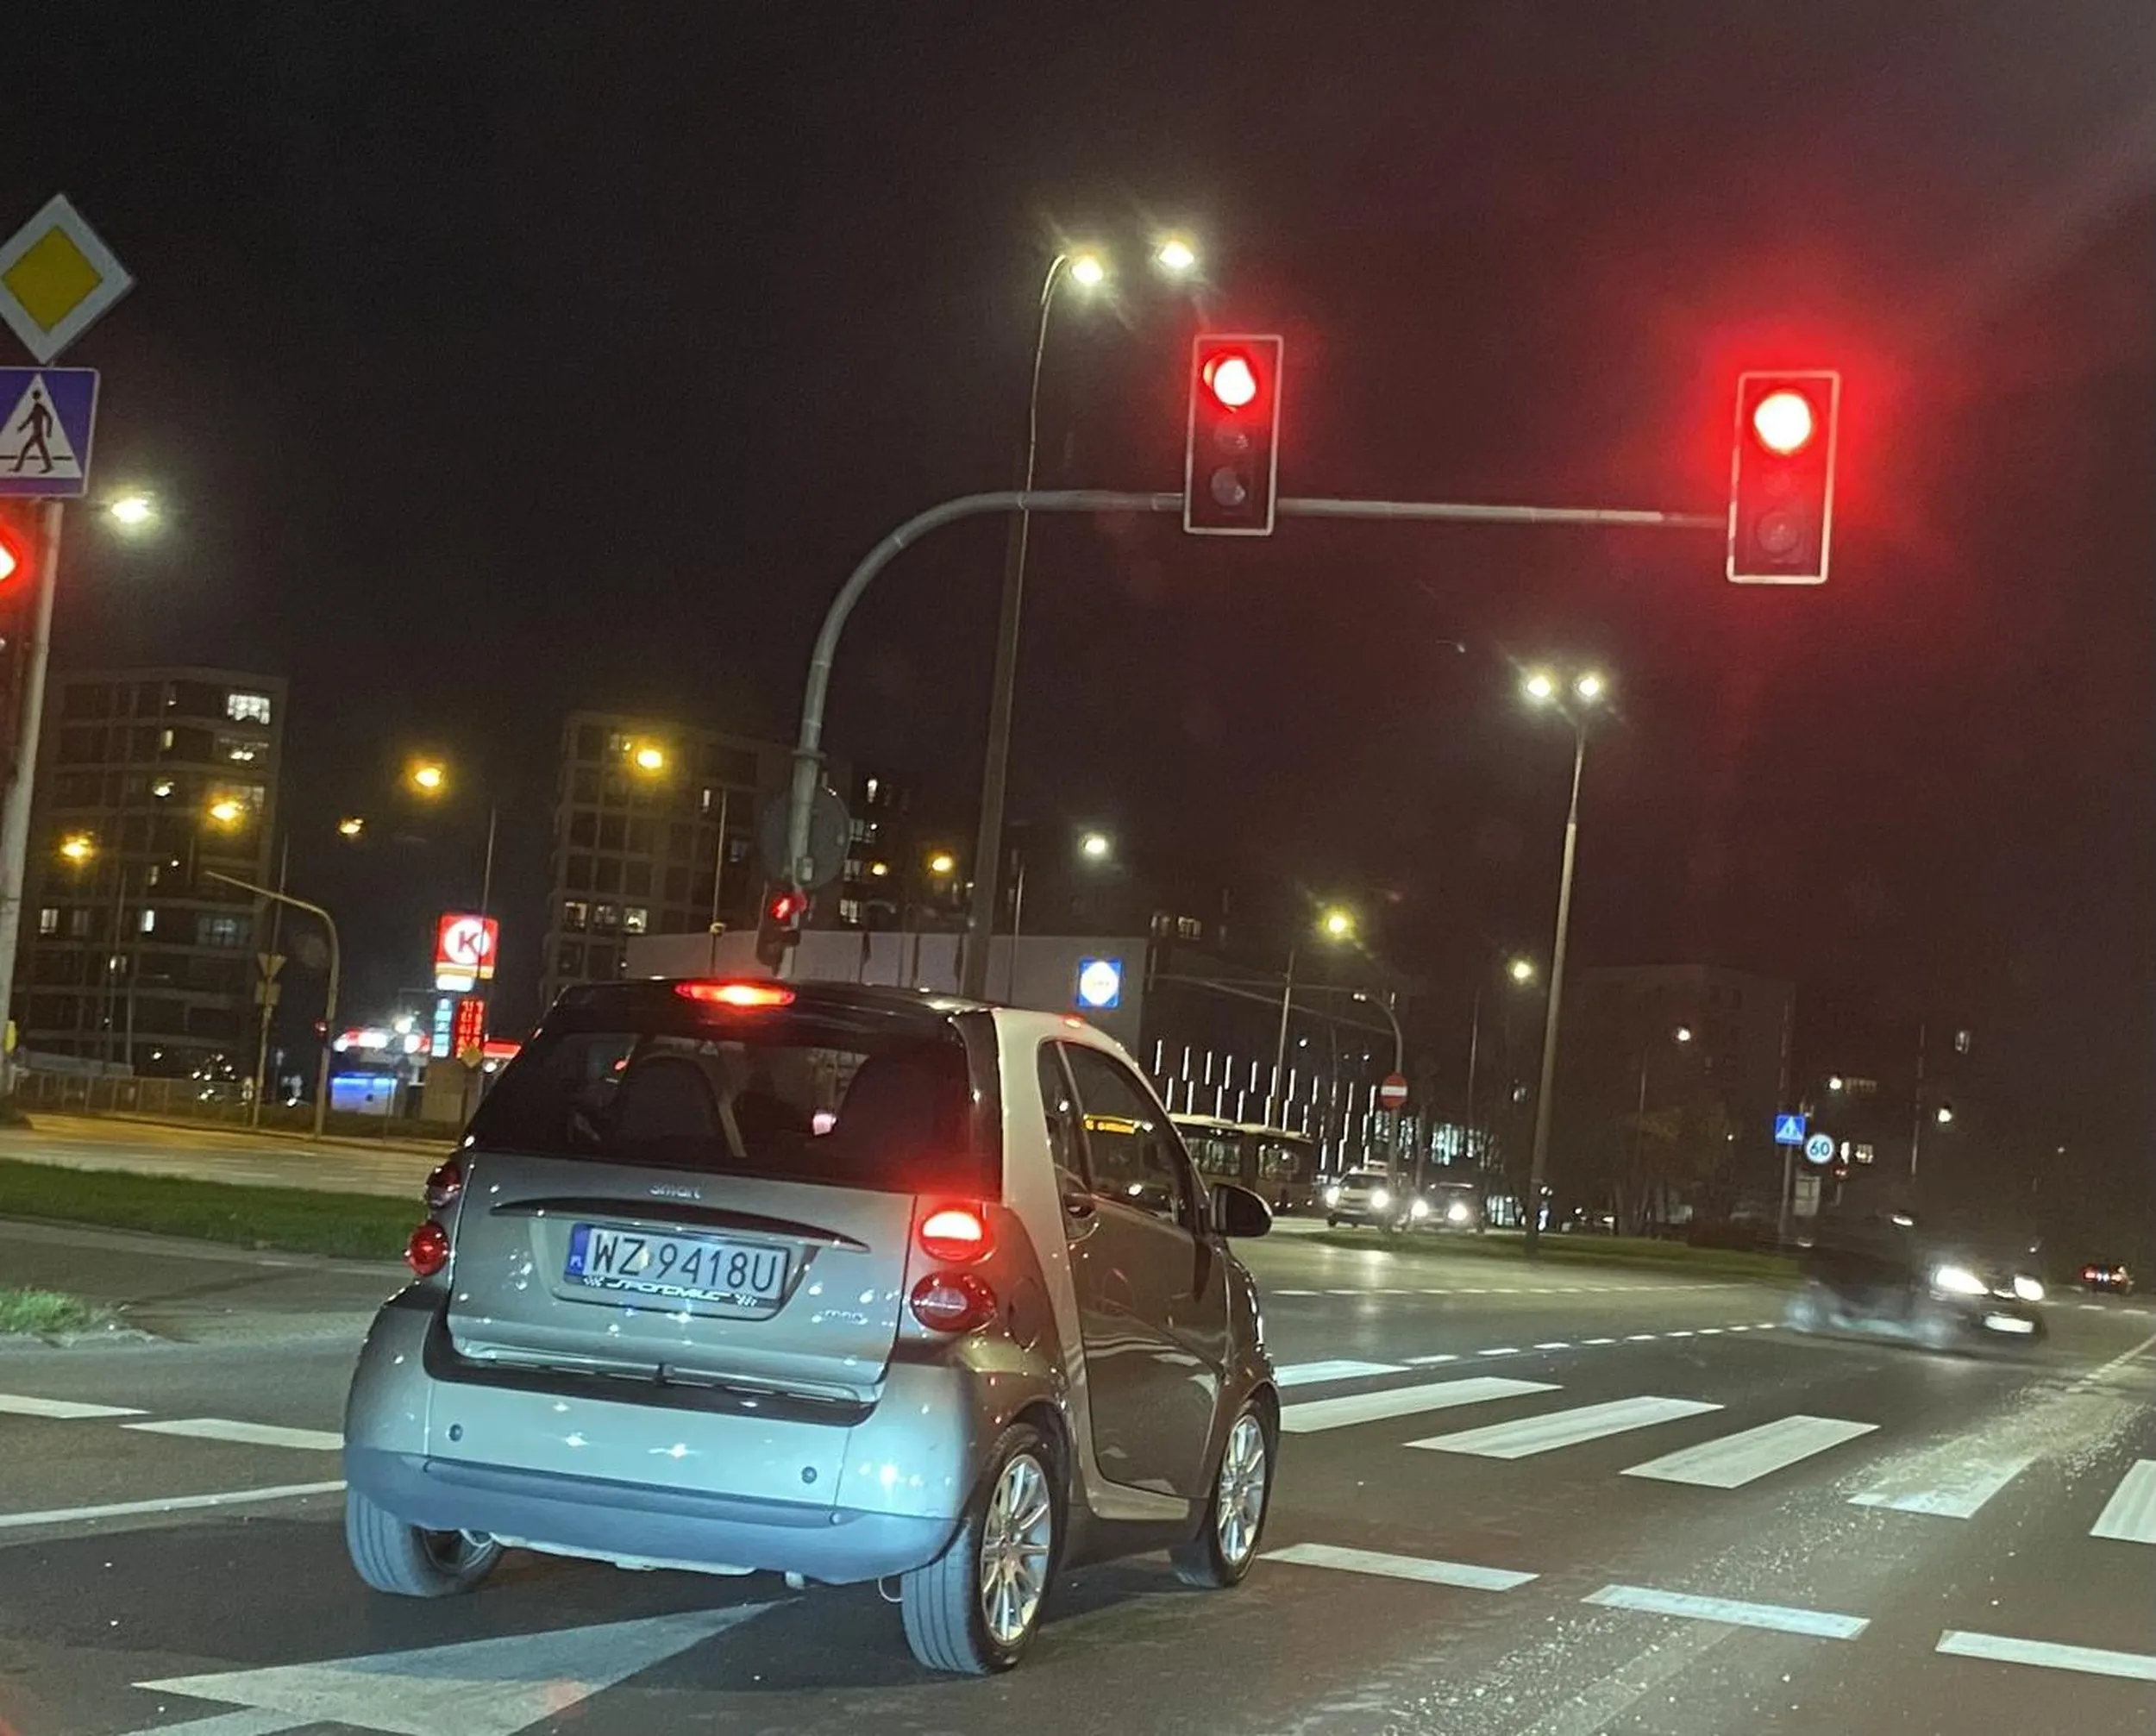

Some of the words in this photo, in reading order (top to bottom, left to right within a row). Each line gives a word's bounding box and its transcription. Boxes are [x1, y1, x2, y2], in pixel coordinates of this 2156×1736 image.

[457, 930, 479, 956] K
[1809, 1141, 1830, 1156] 60
[650, 1181, 702, 1199] smart
[592, 1234, 645, 1276] WZ
[657, 1243, 776, 1292] 9418U
